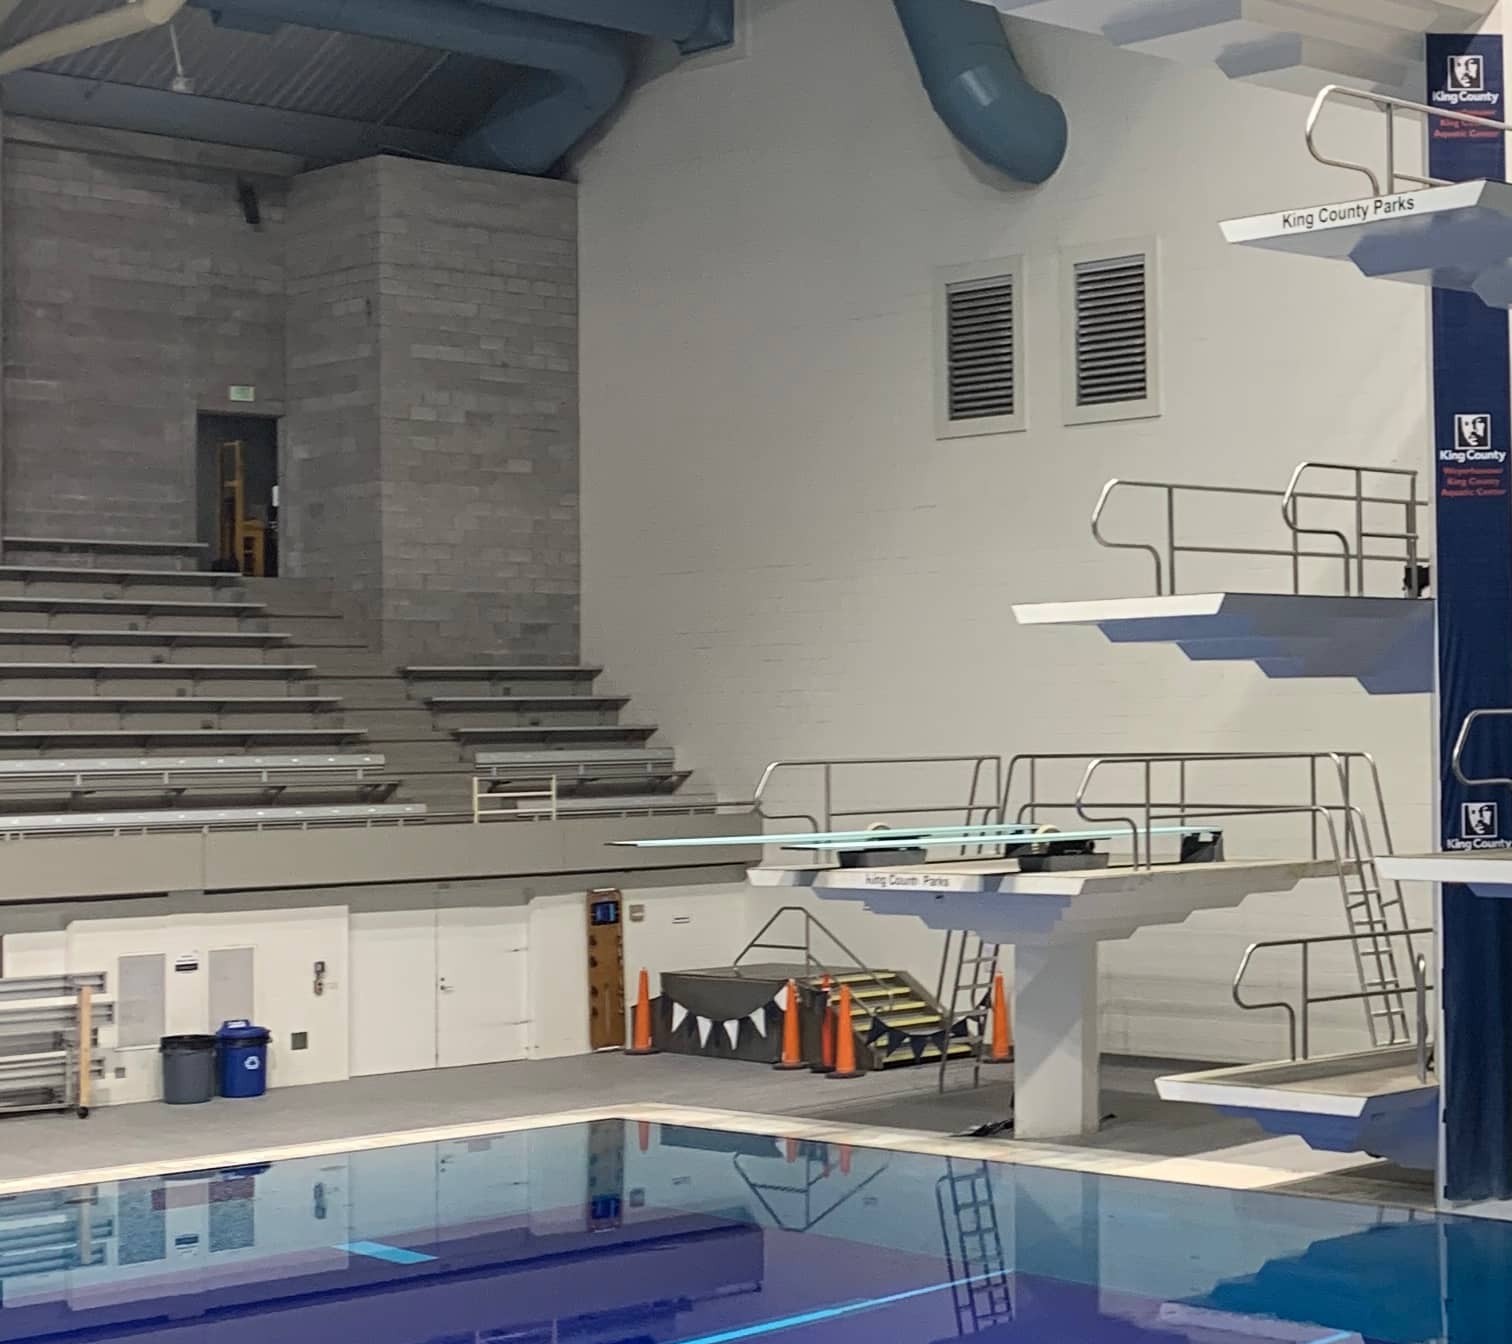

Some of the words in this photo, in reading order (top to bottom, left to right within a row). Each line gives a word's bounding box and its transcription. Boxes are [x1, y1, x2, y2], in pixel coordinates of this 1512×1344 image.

[1432, 91, 1458, 104] King
[1459, 91, 1499, 104] County
[1282, 212, 1314, 229] King
[1318, 203, 1369, 223] County
[1373, 196, 1415, 215] Parks
[1439, 450, 1466, 463] King
[1466, 449, 1506, 463] County
[1446, 839, 1473, 851] King
[1473, 839, 1512, 849] County
